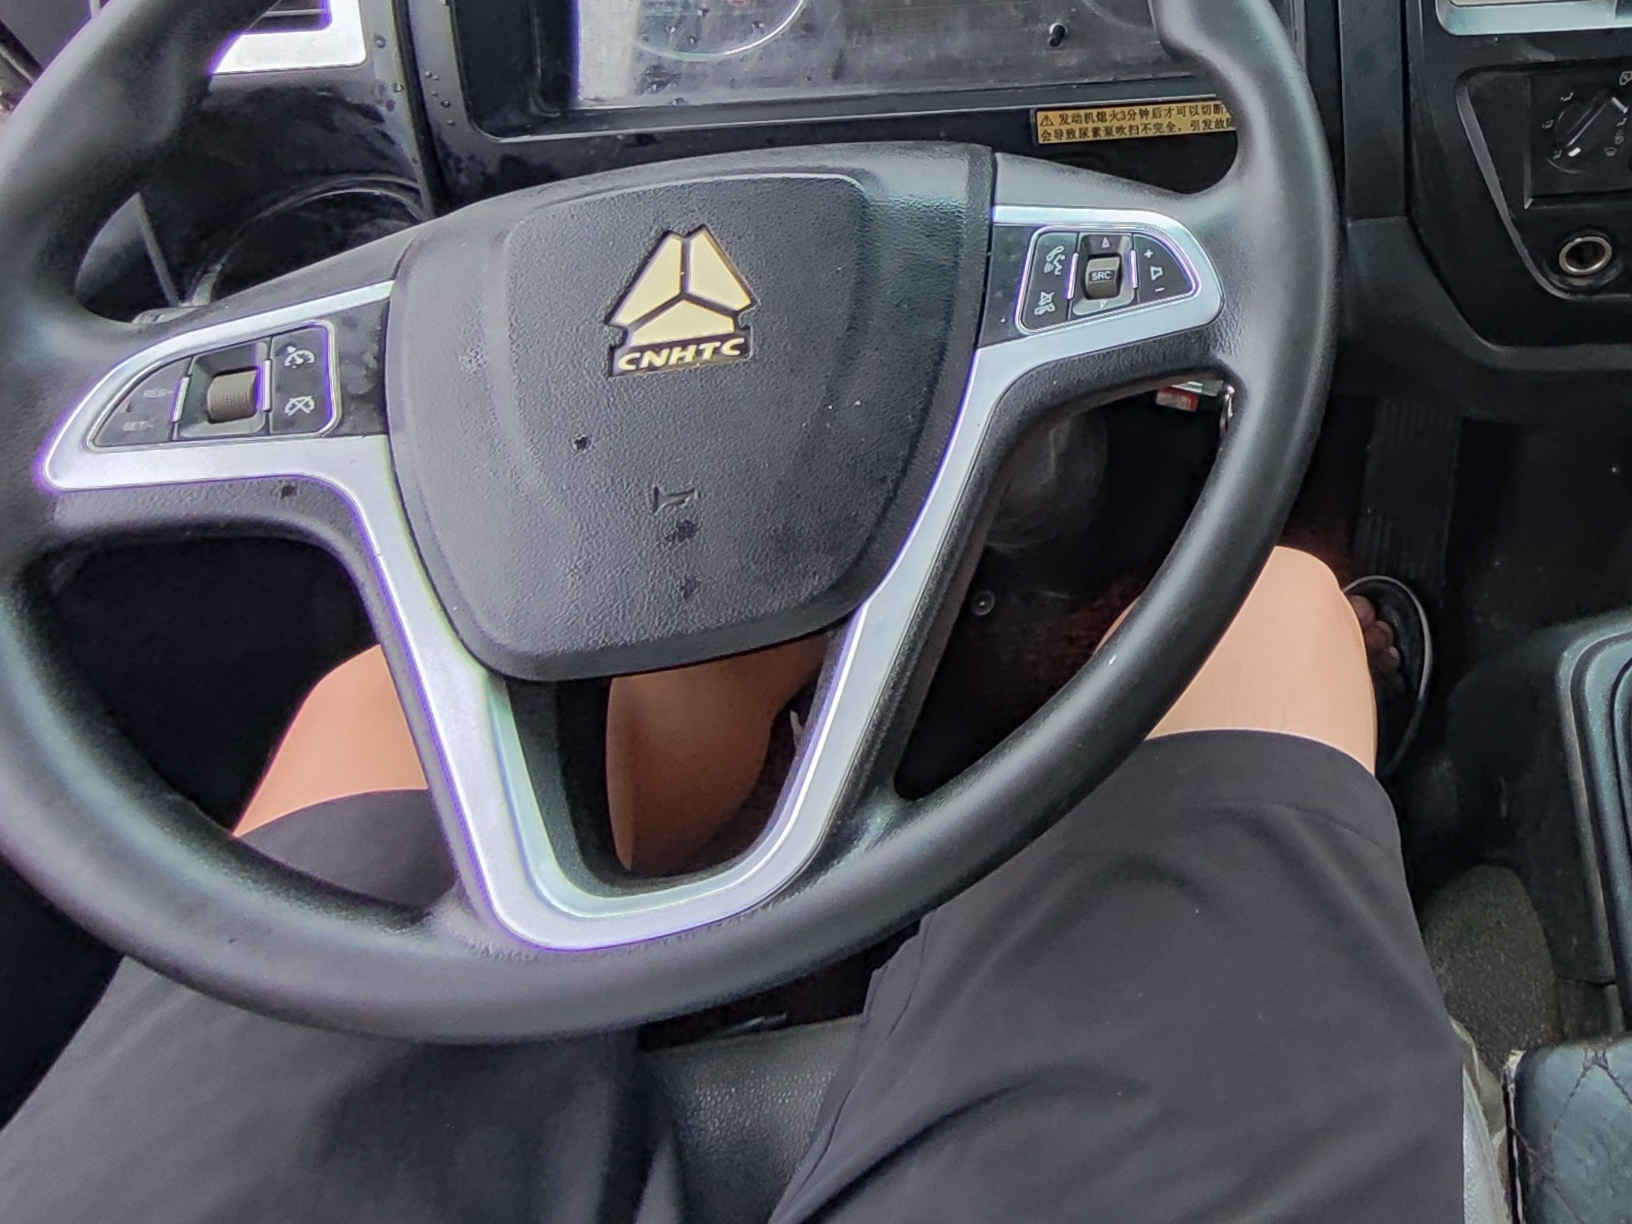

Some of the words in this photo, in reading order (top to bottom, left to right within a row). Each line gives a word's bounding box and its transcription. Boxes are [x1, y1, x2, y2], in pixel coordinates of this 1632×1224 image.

[1058, 103, 1229, 126] 发动机熄火3分钟后才可以切断
[1091, 271, 1112, 281] SRC
[618, 337, 745, 371] CNHTC
